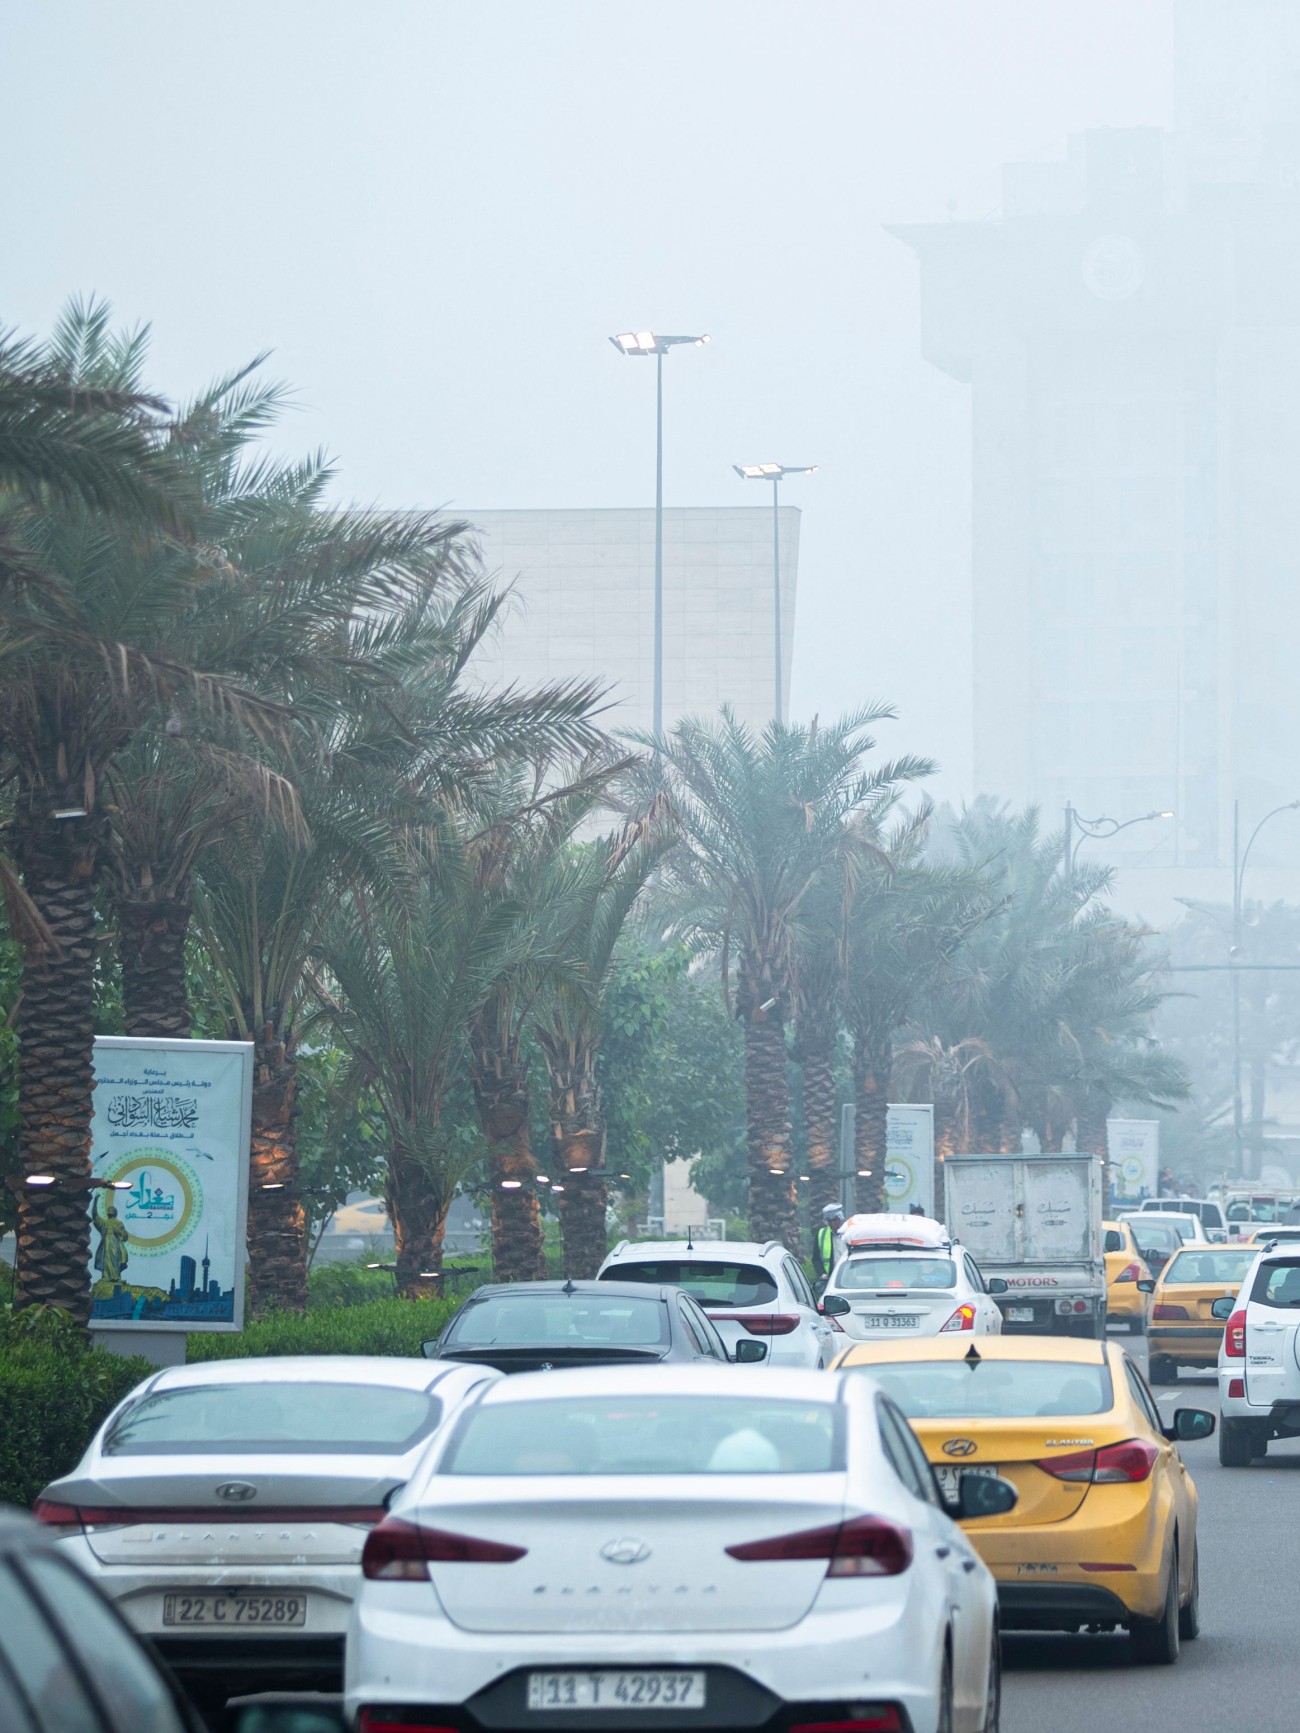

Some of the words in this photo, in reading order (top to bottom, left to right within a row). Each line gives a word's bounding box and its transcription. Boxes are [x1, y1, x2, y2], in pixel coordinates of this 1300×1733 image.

[143, 1068, 167, 1076] برعاية
[97, 1077, 123, 1085] المحترم
[124, 1078, 149, 1087] الوزراء
[149, 1079, 171, 1087] مجلس
[171, 1080, 191, 1088] رئيس
[191, 1080, 212, 1088] دولة
[129, 1131, 149, 1139] بغداد
[169, 1132, 195, 1140] انطلاق
[1006, 1277, 1059, 1287] MOTORS
[870, 1318, 880, 1327] 11
[891, 1317, 917, 1327] 31363
[156, 1532, 317, 1541] ELANTRA
[533, 1585, 717, 1595] ELANTRA
[180, 1598, 205, 1621] 22
[213, 1599, 226, 1621] C
[235, 1599, 299, 1622] 75289
[547, 1677, 577, 1704] 11
[589, 1677, 605, 1704] T
[614, 1676, 694, 1704] 42937
